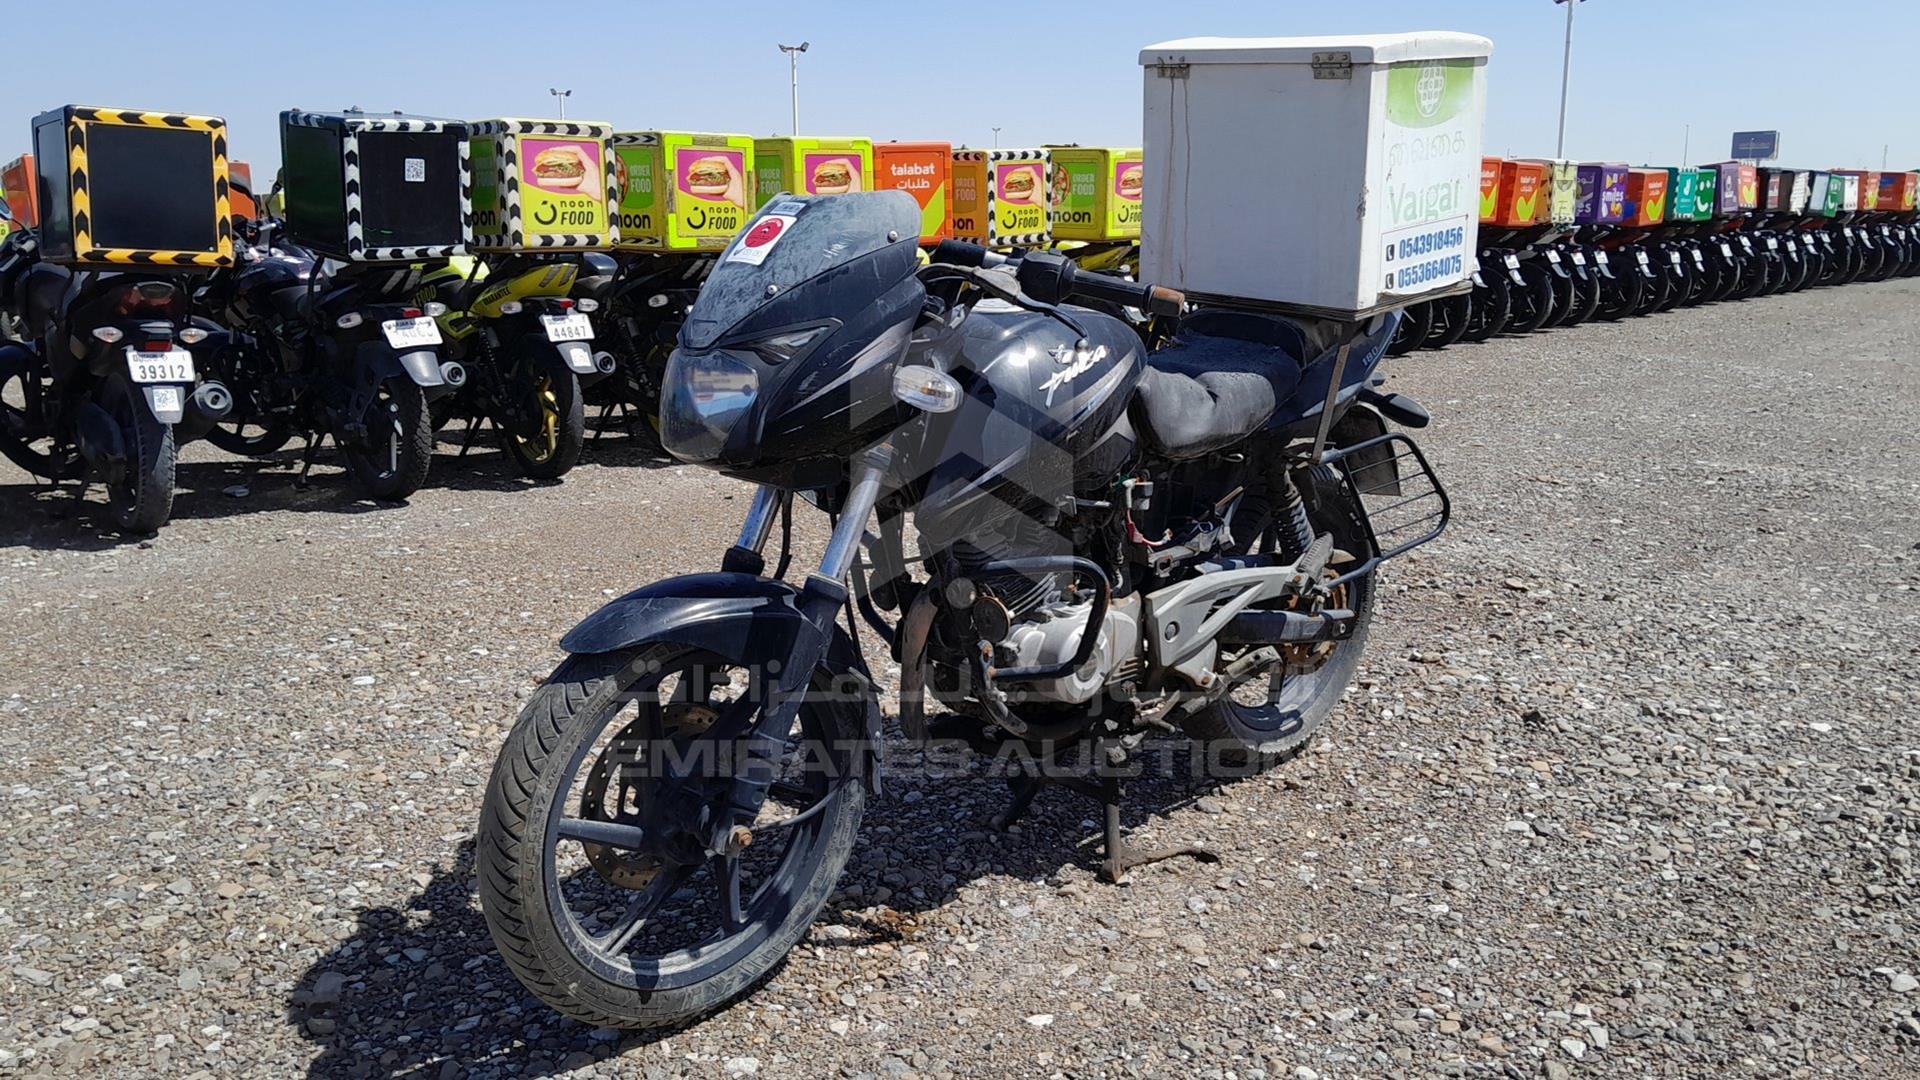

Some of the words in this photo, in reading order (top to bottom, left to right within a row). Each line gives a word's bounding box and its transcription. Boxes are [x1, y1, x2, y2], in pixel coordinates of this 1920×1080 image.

[890, 163, 936, 176] talabat
[630, 178, 652, 193] FOOD
[896, 178, 931, 191] طلبات
[1072, 183, 1096, 196] FOOD
[955, 188, 977, 201] FOOD
[560, 200, 594, 208] noon
[708, 206, 737, 214] noon
[471, 209, 496, 227] oon
[560, 211, 594, 226] FOOD
[708, 216, 737, 230] FOOD
[952, 217, 974, 231] on
[1017, 217, 1039, 229] FOOD
[1053, 210, 1091, 224] noon
[1398, 225, 1464, 260] 0543918456
[1397, 254, 1462, 289] 0553664075
[553, 325, 587, 339] 44847
[1362, 345, 1379, 366] 180
[138, 364, 186, 379] 39312
